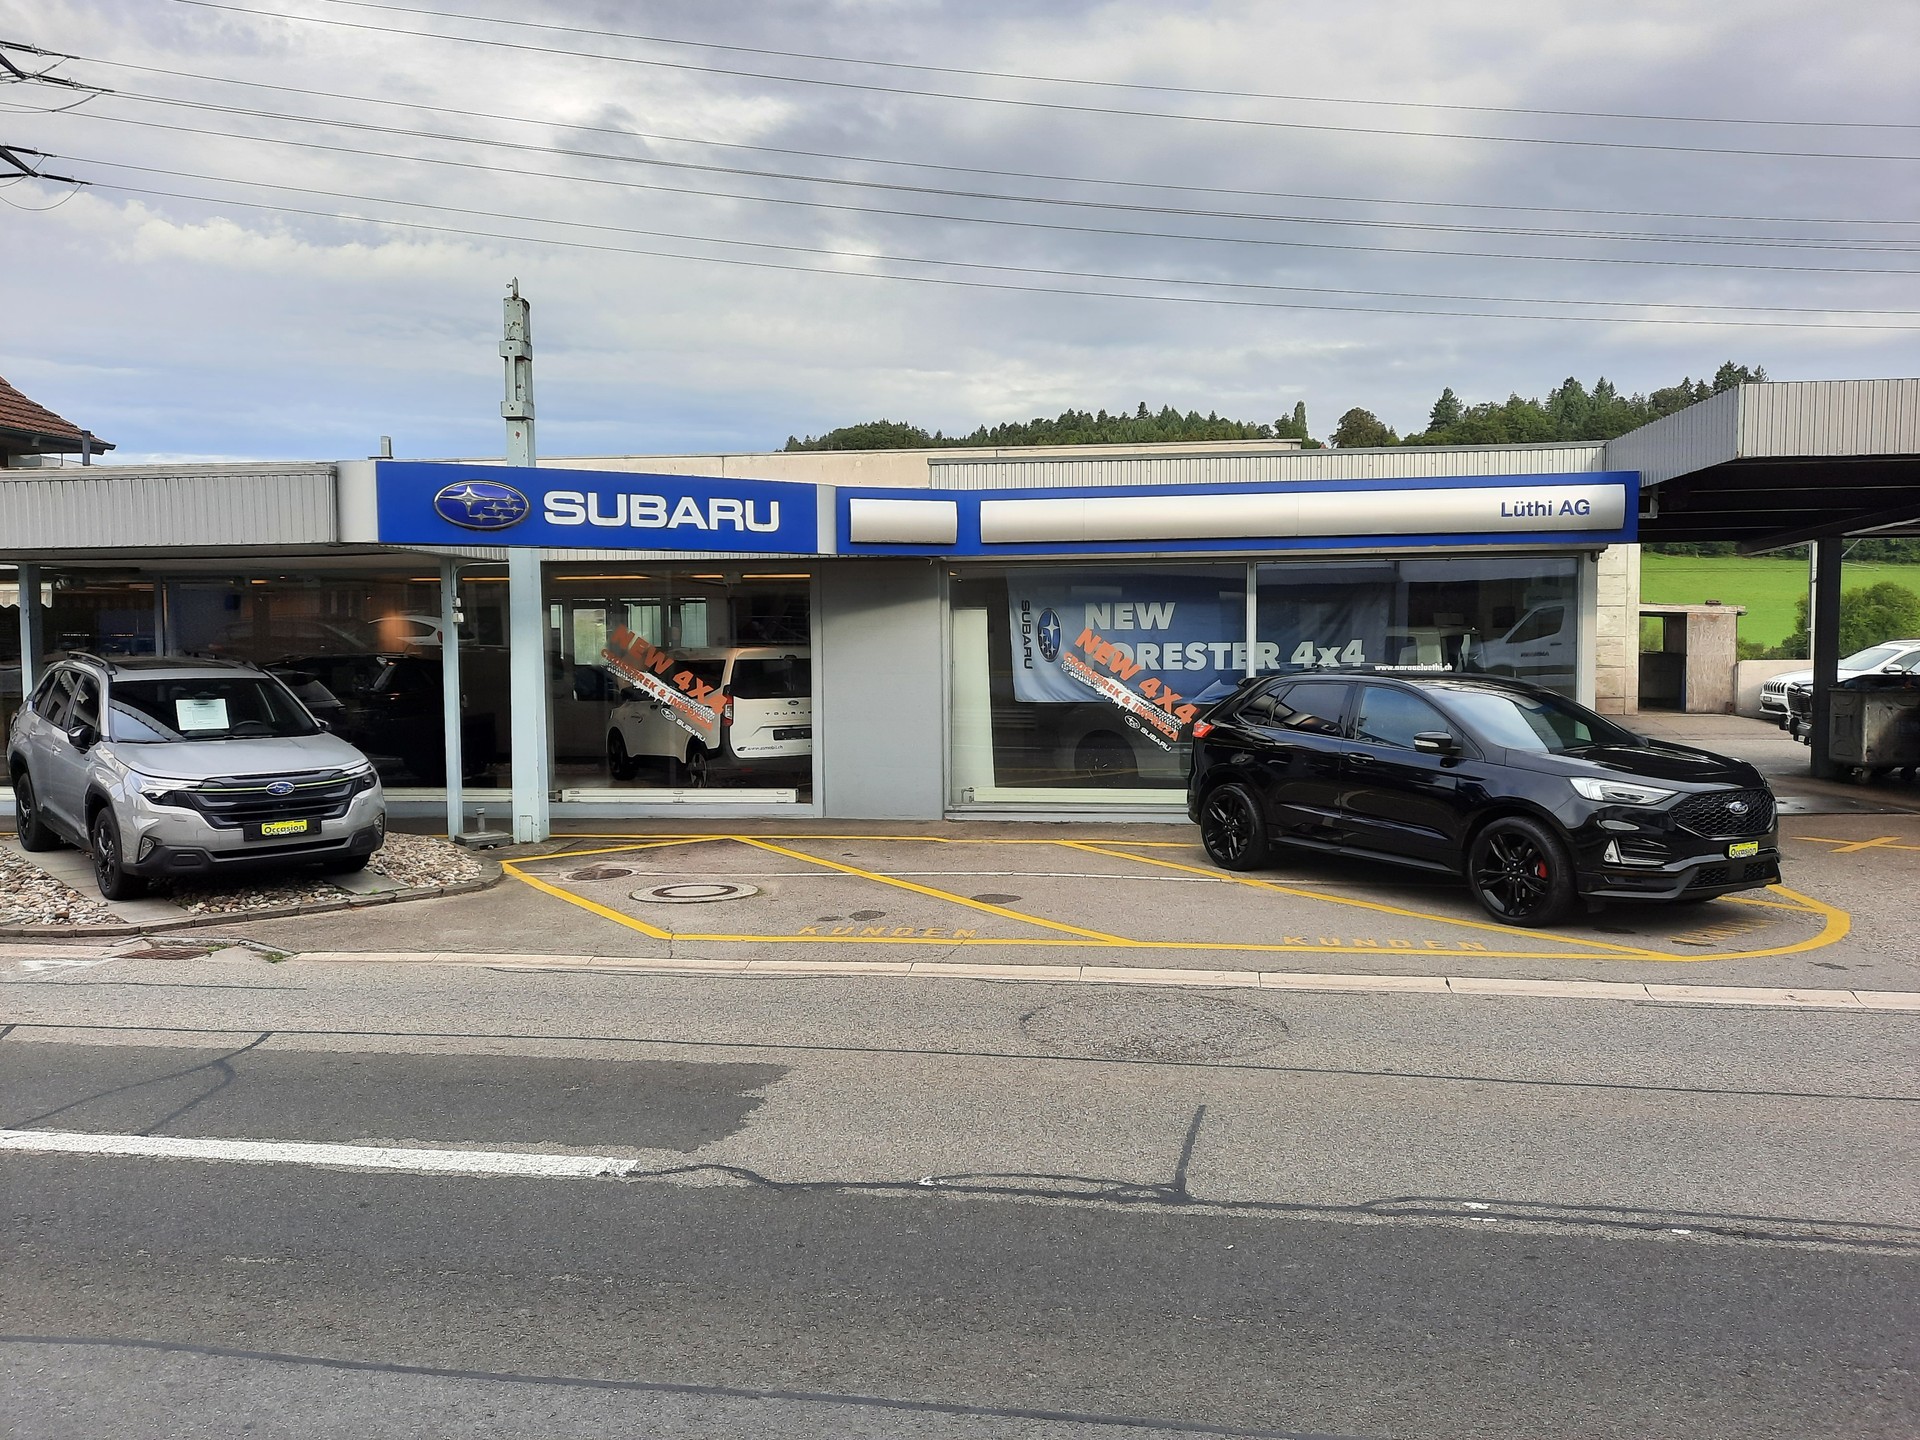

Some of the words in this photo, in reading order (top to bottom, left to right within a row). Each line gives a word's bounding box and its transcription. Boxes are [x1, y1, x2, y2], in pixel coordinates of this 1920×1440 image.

[543, 490, 780, 533] SUBARU
[1500, 500, 1553, 518] Lüthi
[1558, 498, 1591, 516] AG
[1085, 602, 1176, 630] NEW
[1021, 599, 1034, 670] SUBARU
[1290, 639, 1366, 668] 4x4
[610, 623, 675, 675] NEW
[672, 670, 728, 715] 4X4
[1074, 627, 1143, 681] NEW
[1138, 677, 1199, 725] 4X4
[1121, 695, 1131, 706] &
[675, 718, 706, 743] SUBARU
[1140, 726, 1172, 752] SUBARU
[264, 824, 305, 835] Occasion
[1730, 846, 1757, 857] Occasion
[798, 925, 977, 938] KUNDEN
[1282, 936, 1488, 951] KUNDEN
